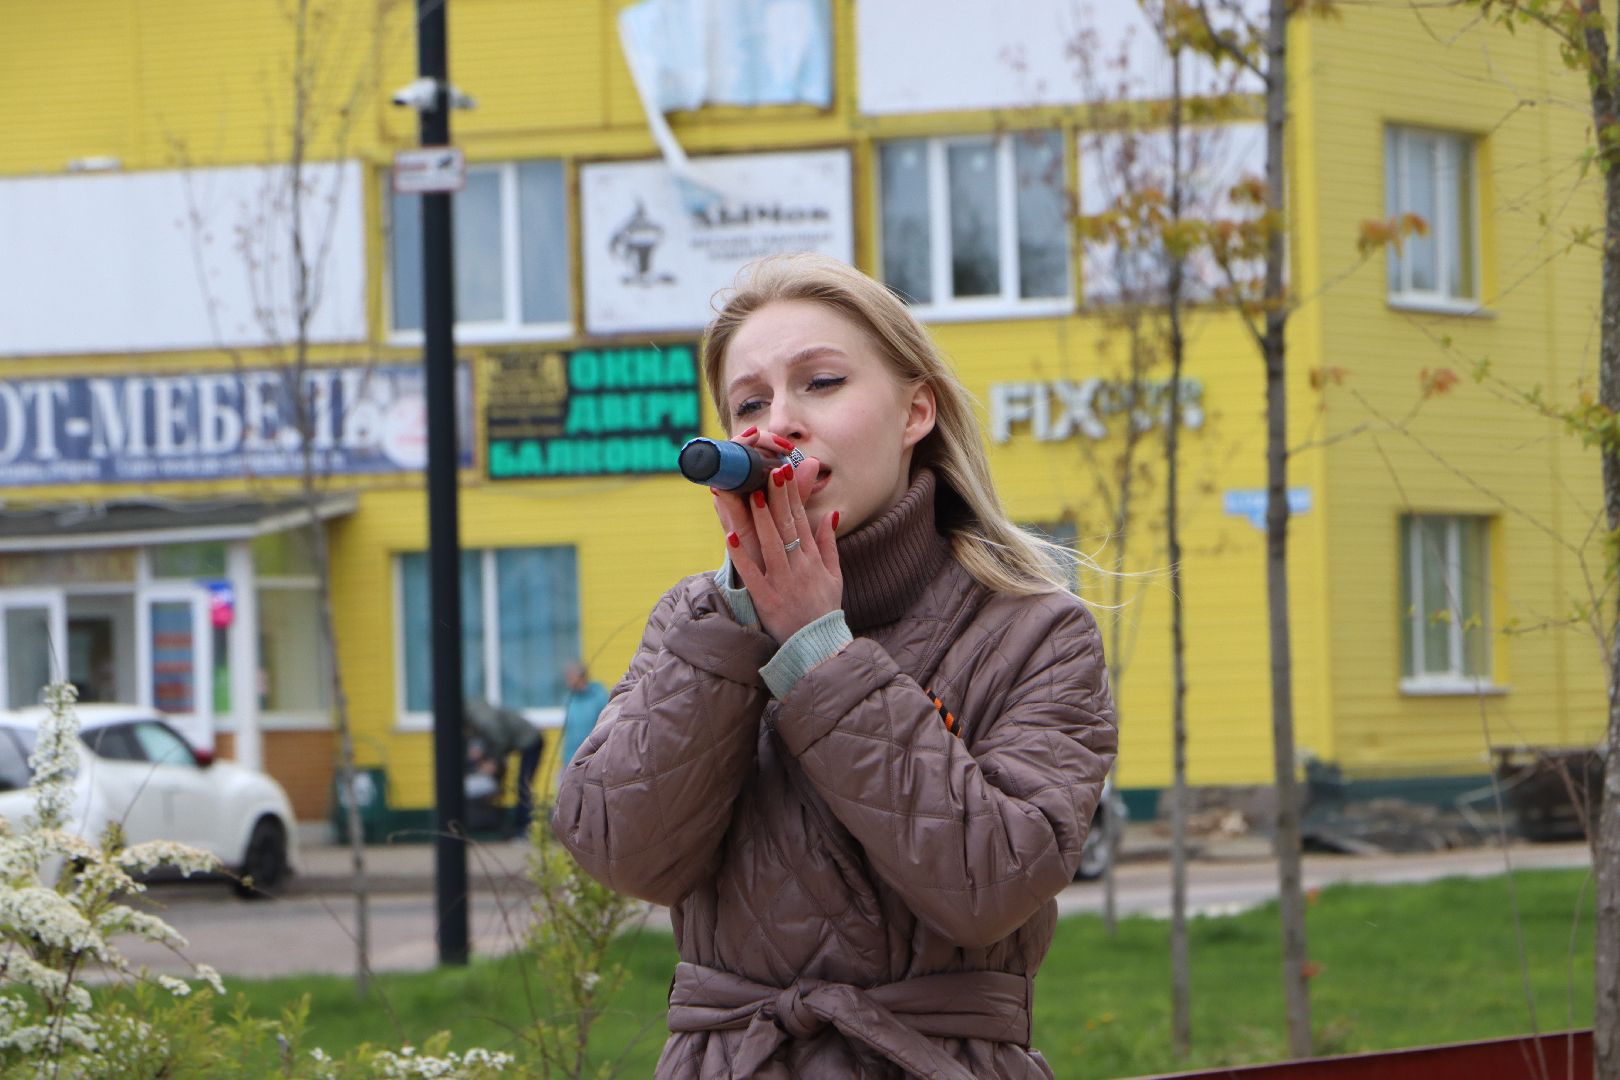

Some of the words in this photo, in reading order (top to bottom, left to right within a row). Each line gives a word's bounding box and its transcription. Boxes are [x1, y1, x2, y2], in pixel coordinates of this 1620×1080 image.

[570, 346, 696, 389] ОКНА
[566, 391, 698, 433] ДВЕРИ
[989, 378, 1106, 443] FIX
